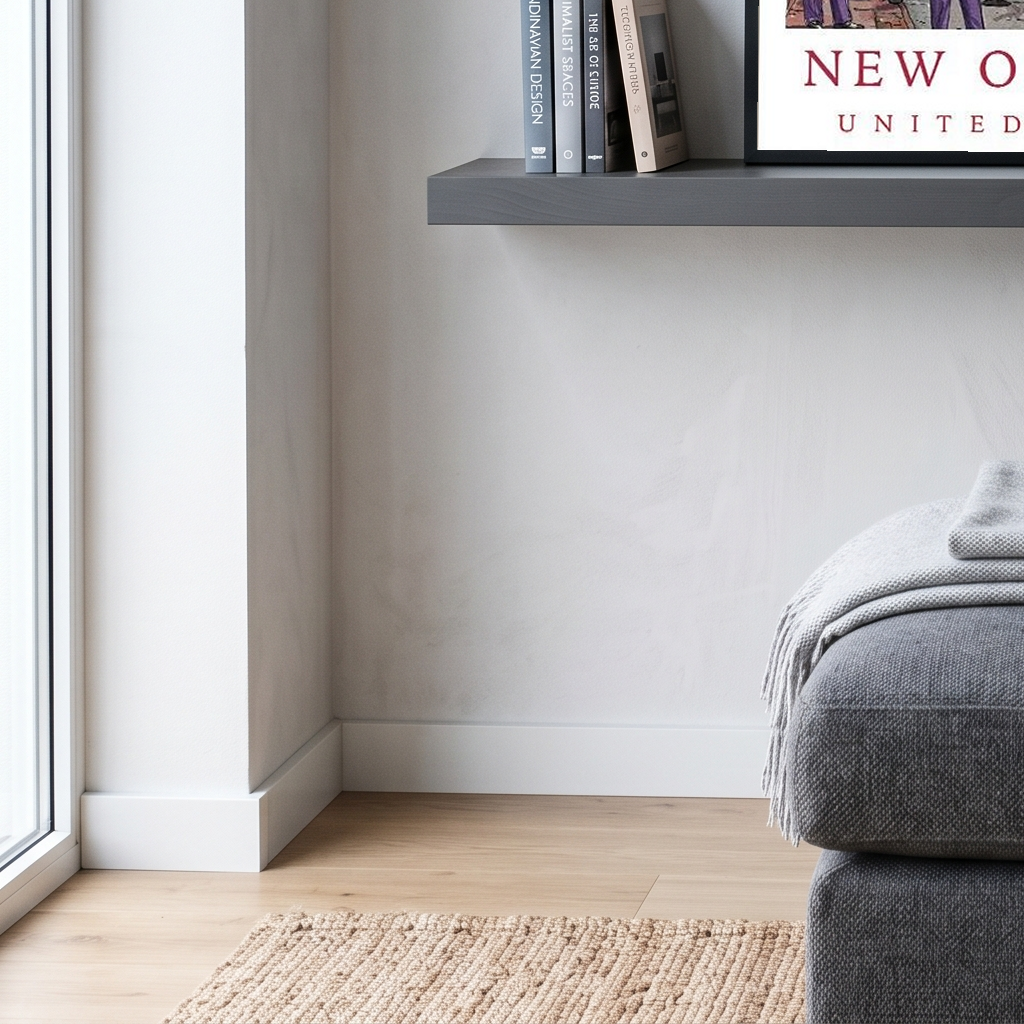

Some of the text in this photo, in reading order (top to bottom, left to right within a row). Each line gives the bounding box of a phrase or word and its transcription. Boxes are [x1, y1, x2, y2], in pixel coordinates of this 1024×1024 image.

[804, 50, 946, 88] NEW
[530, 74, 543, 125] DESIGN
[838, 114, 1022, 133] UNITED
